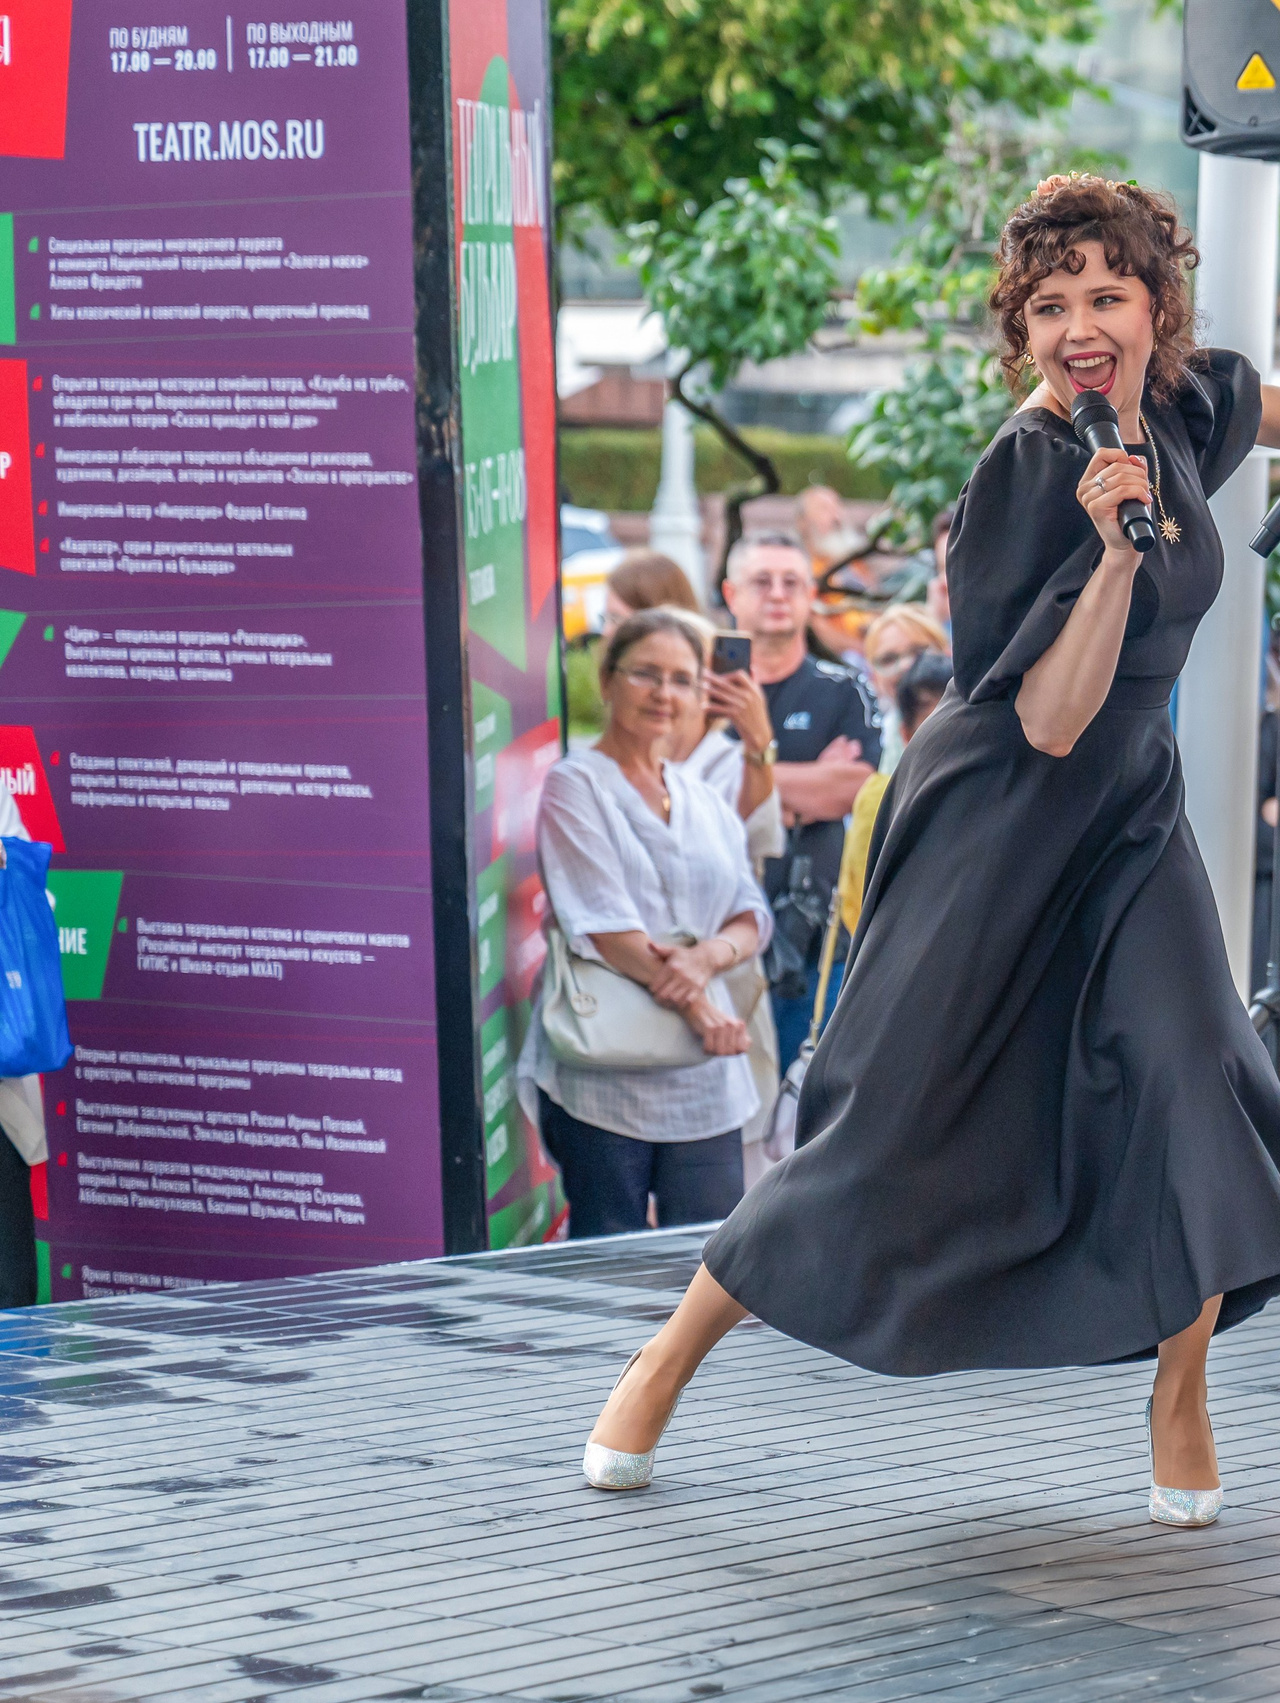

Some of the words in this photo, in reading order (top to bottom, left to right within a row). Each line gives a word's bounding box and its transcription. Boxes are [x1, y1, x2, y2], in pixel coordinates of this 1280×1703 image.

[109, 27, 128, 48] ПО
[131, 25, 188, 49] БУДНЯМ
[246, 23, 266, 44] ПО
[270, 20, 352, 44] ВЫХОДНЫМ
[112, 51, 150, 72] 17.00
[174, 48, 216, 70] 20.00
[249, 46, 289, 68] 17.00
[314, 44, 358, 66] 21.00
[133, 119, 324, 162] TEATR.MOS.RU
